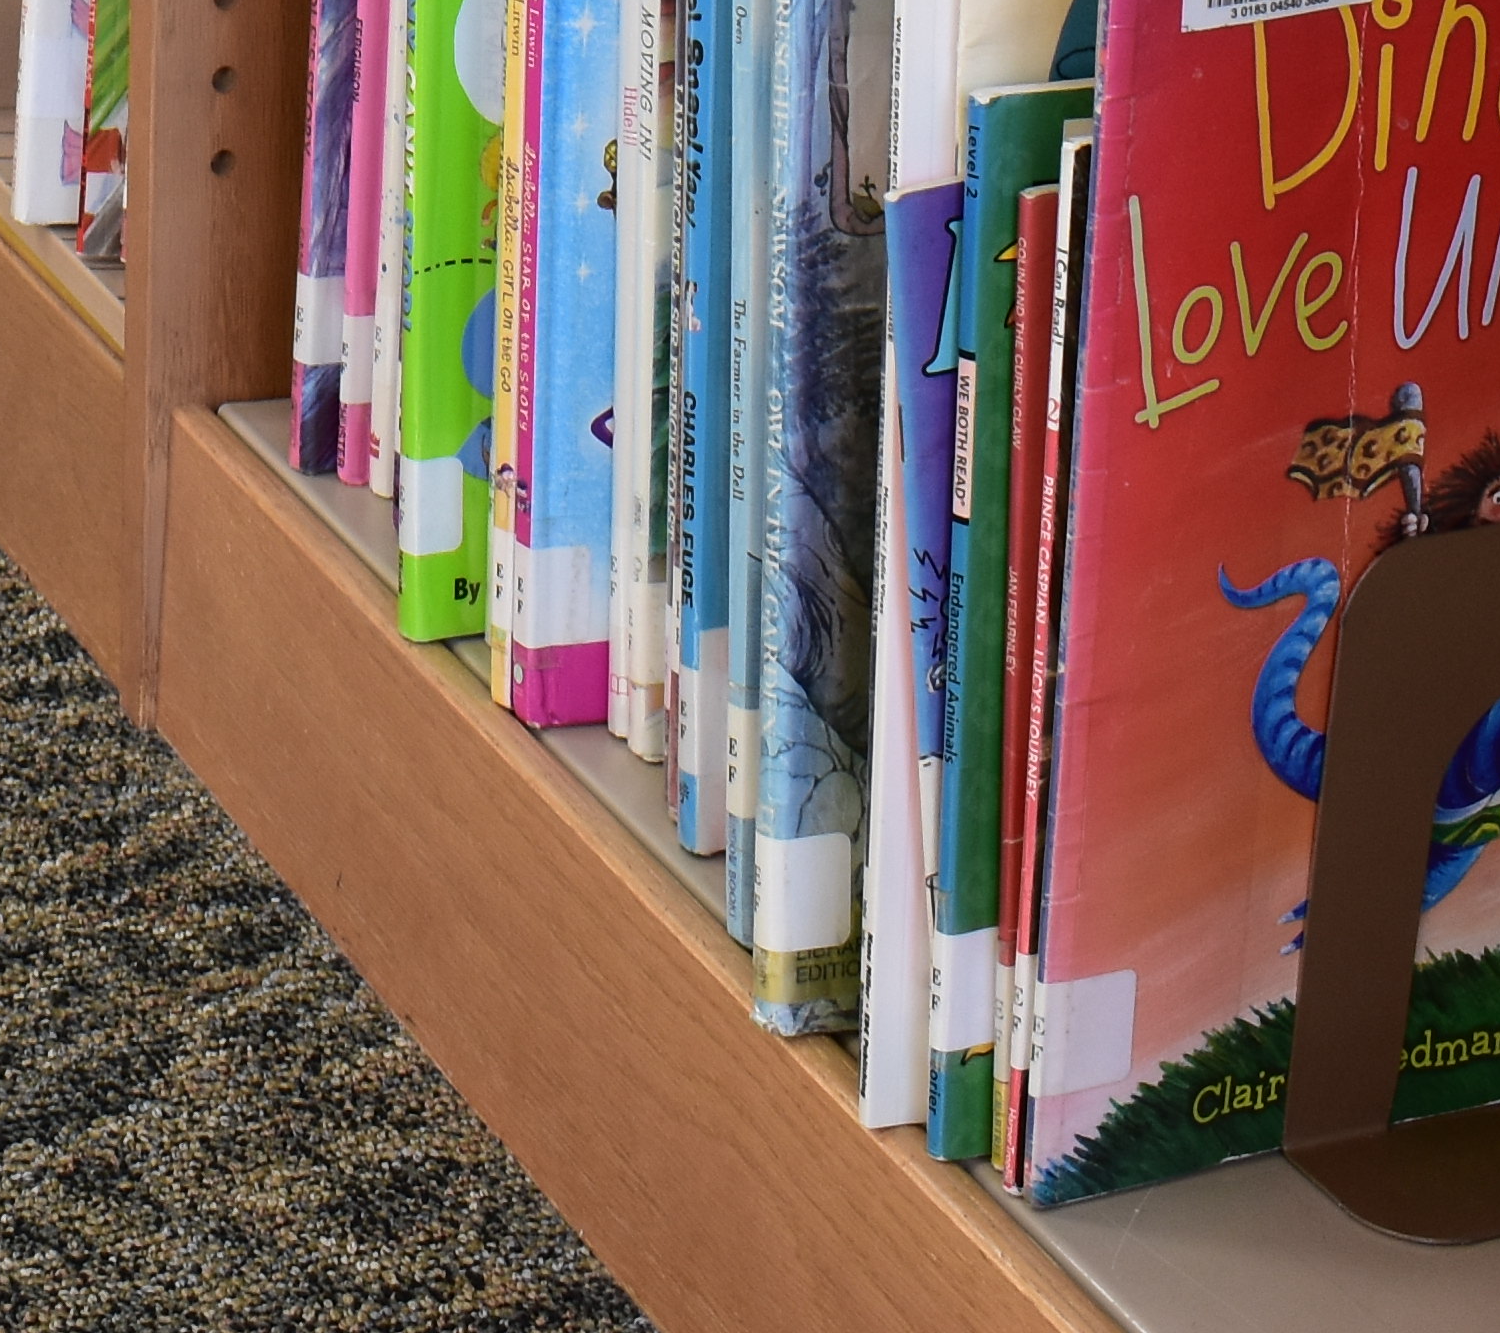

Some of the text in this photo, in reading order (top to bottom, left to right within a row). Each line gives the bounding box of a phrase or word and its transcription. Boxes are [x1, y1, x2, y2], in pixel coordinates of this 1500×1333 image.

[1230, 7, 1238, 19] 3
[1240, 2, 1267, 15] 0183
[640, 6, 653, 114] MOVING
[639, 124, 651, 160] IN!
[966, 124, 978, 197] Level 2
[1128, 193, 1351, 429] Love
[732, 299, 746, 500] The Farmer in the Dell
[958, 374, 970, 400] WE
[956, 405, 969, 449] BOTH
[454, 577, 480, 604] By
[943, 572, 965, 763] Endangered Animals
[1026, 475, 1053, 800] PRINCE CASPIAN LUCY'S JOURNEY
[1187, 1064, 1291, 1125] Clair
